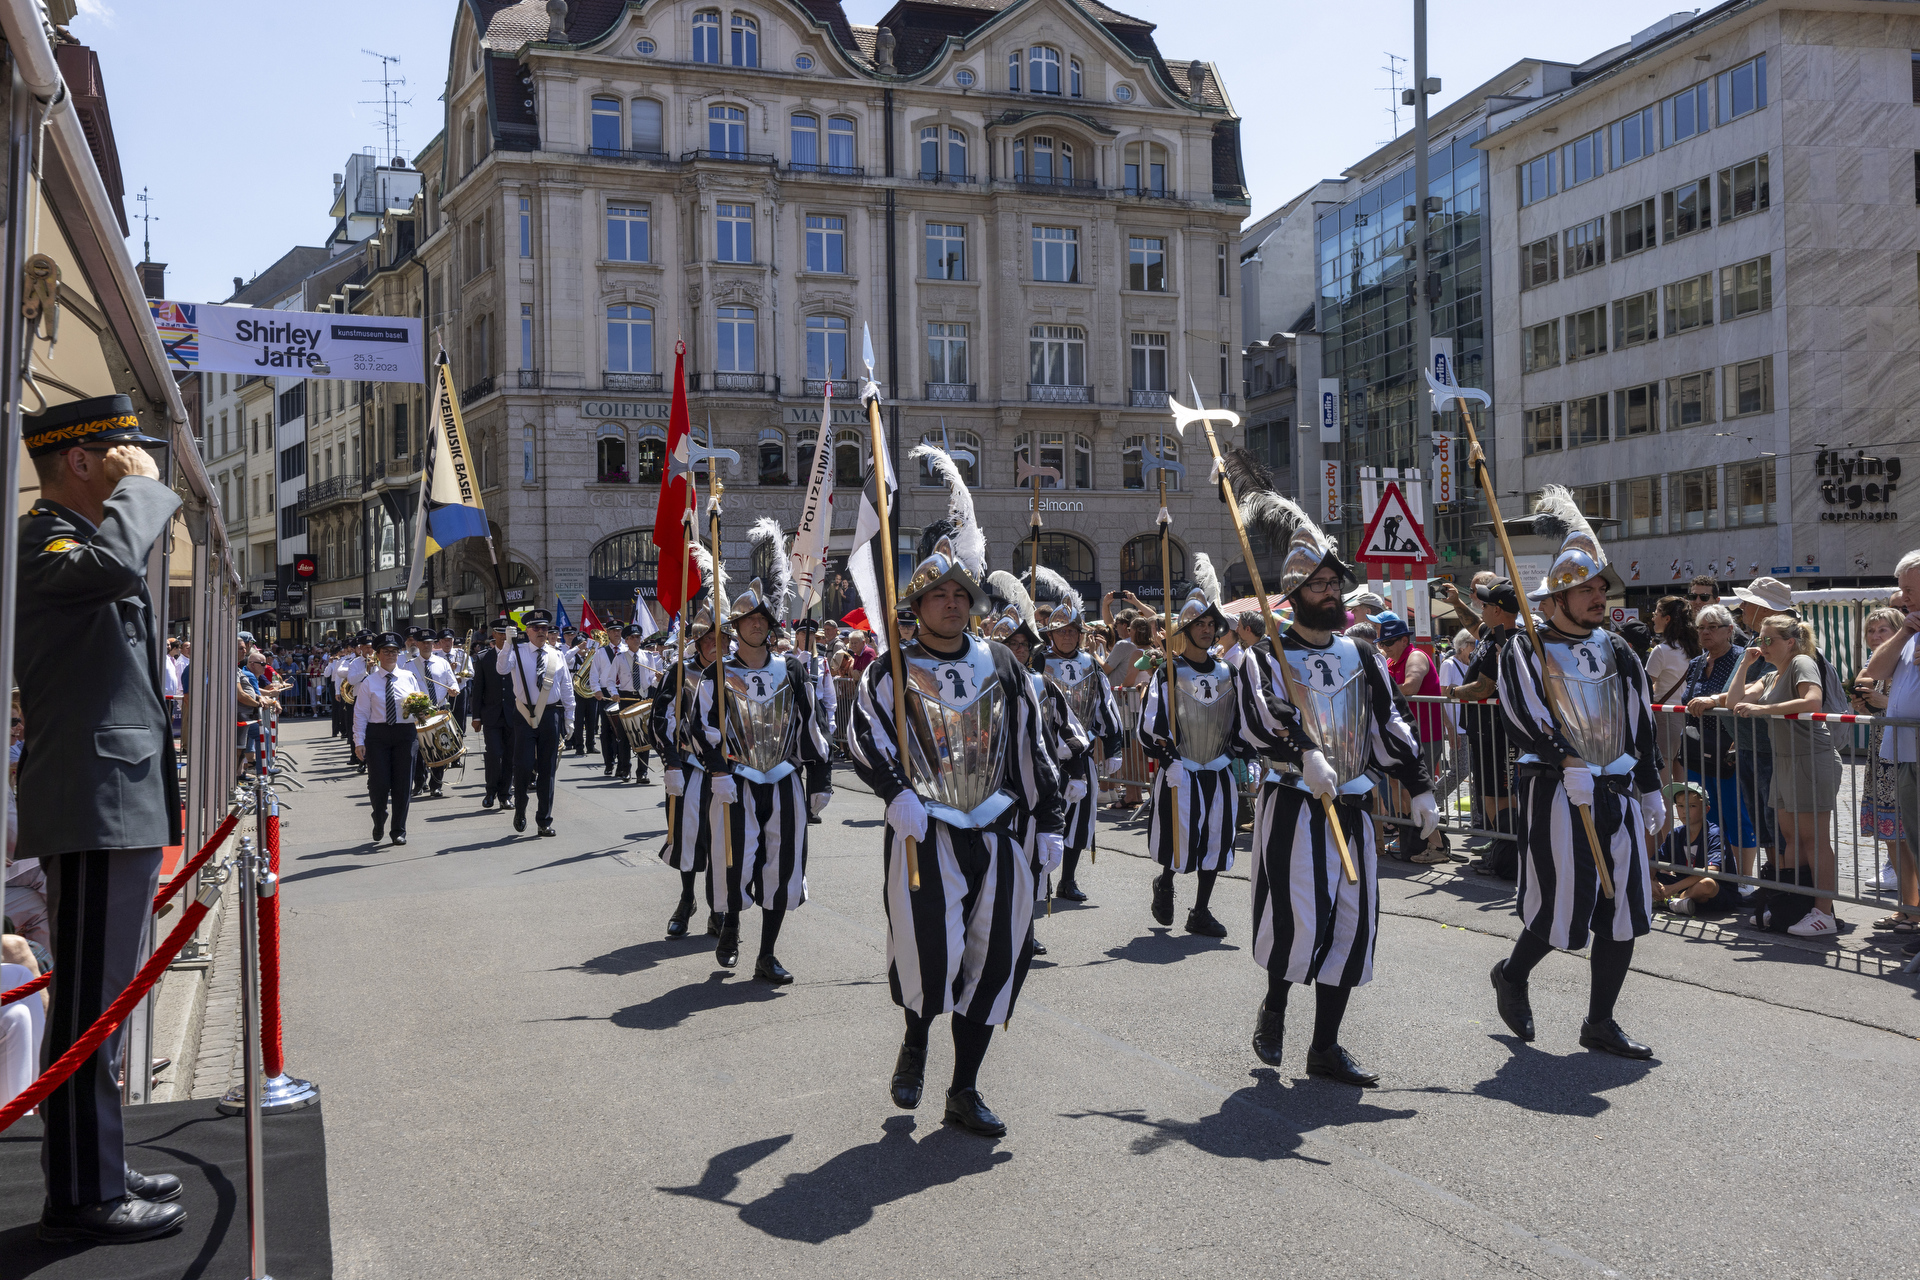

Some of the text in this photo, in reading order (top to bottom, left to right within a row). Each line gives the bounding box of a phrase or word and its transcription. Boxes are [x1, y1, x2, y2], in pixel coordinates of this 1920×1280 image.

[235, 319, 322, 350] Shirley
[337, 328, 403, 339] kunstmuseum basel
[254, 346, 322, 369] Jaffe
[353, 362, 398, 372] 30.7.2023
[1436, 357, 1445, 385] erlitz
[585, 402, 670, 418] COIFFUR
[792, 408, 870, 424] MAIM'S
[1324, 394, 1333, 425] Berlitz
[1438, 434, 1451, 502] coop city
[1816, 450, 1901, 482] flying
[454, 463, 473, 504] BASEL
[1326, 462, 1338, 521] coop city
[1821, 477, 1897, 509] tiger
[590, 491, 660, 508] GENFER
[1821, 510, 1898, 524] copenhagen
[297, 563, 314, 572] Leica
